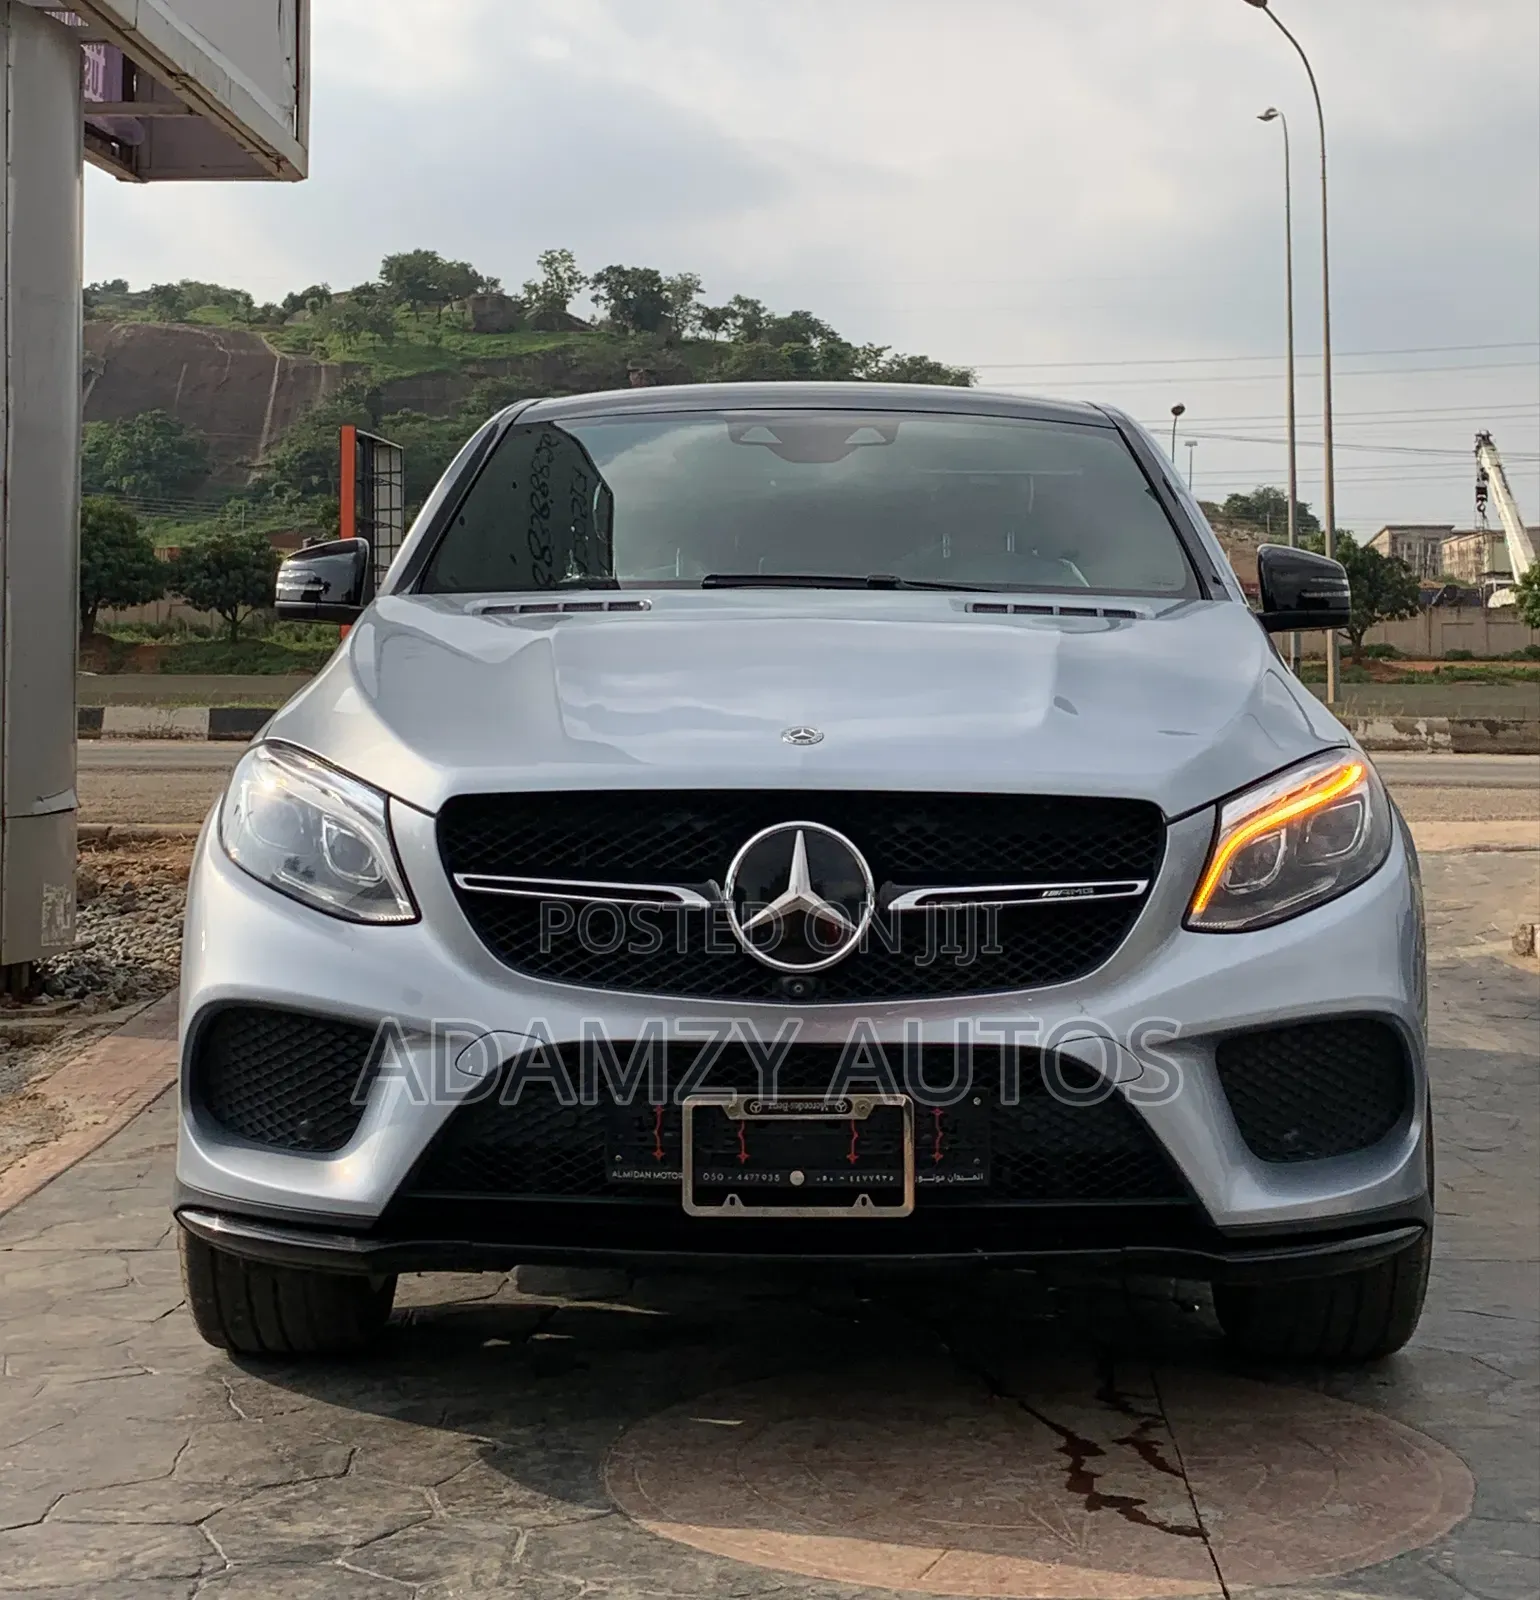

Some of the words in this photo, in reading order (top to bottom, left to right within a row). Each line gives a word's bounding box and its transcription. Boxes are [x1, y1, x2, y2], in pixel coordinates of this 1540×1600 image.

[1059, 886, 1095, 897] AMG
[612, 1170, 652, 1180] ALMIDAN
[702, 1172, 724, 1181] 050
